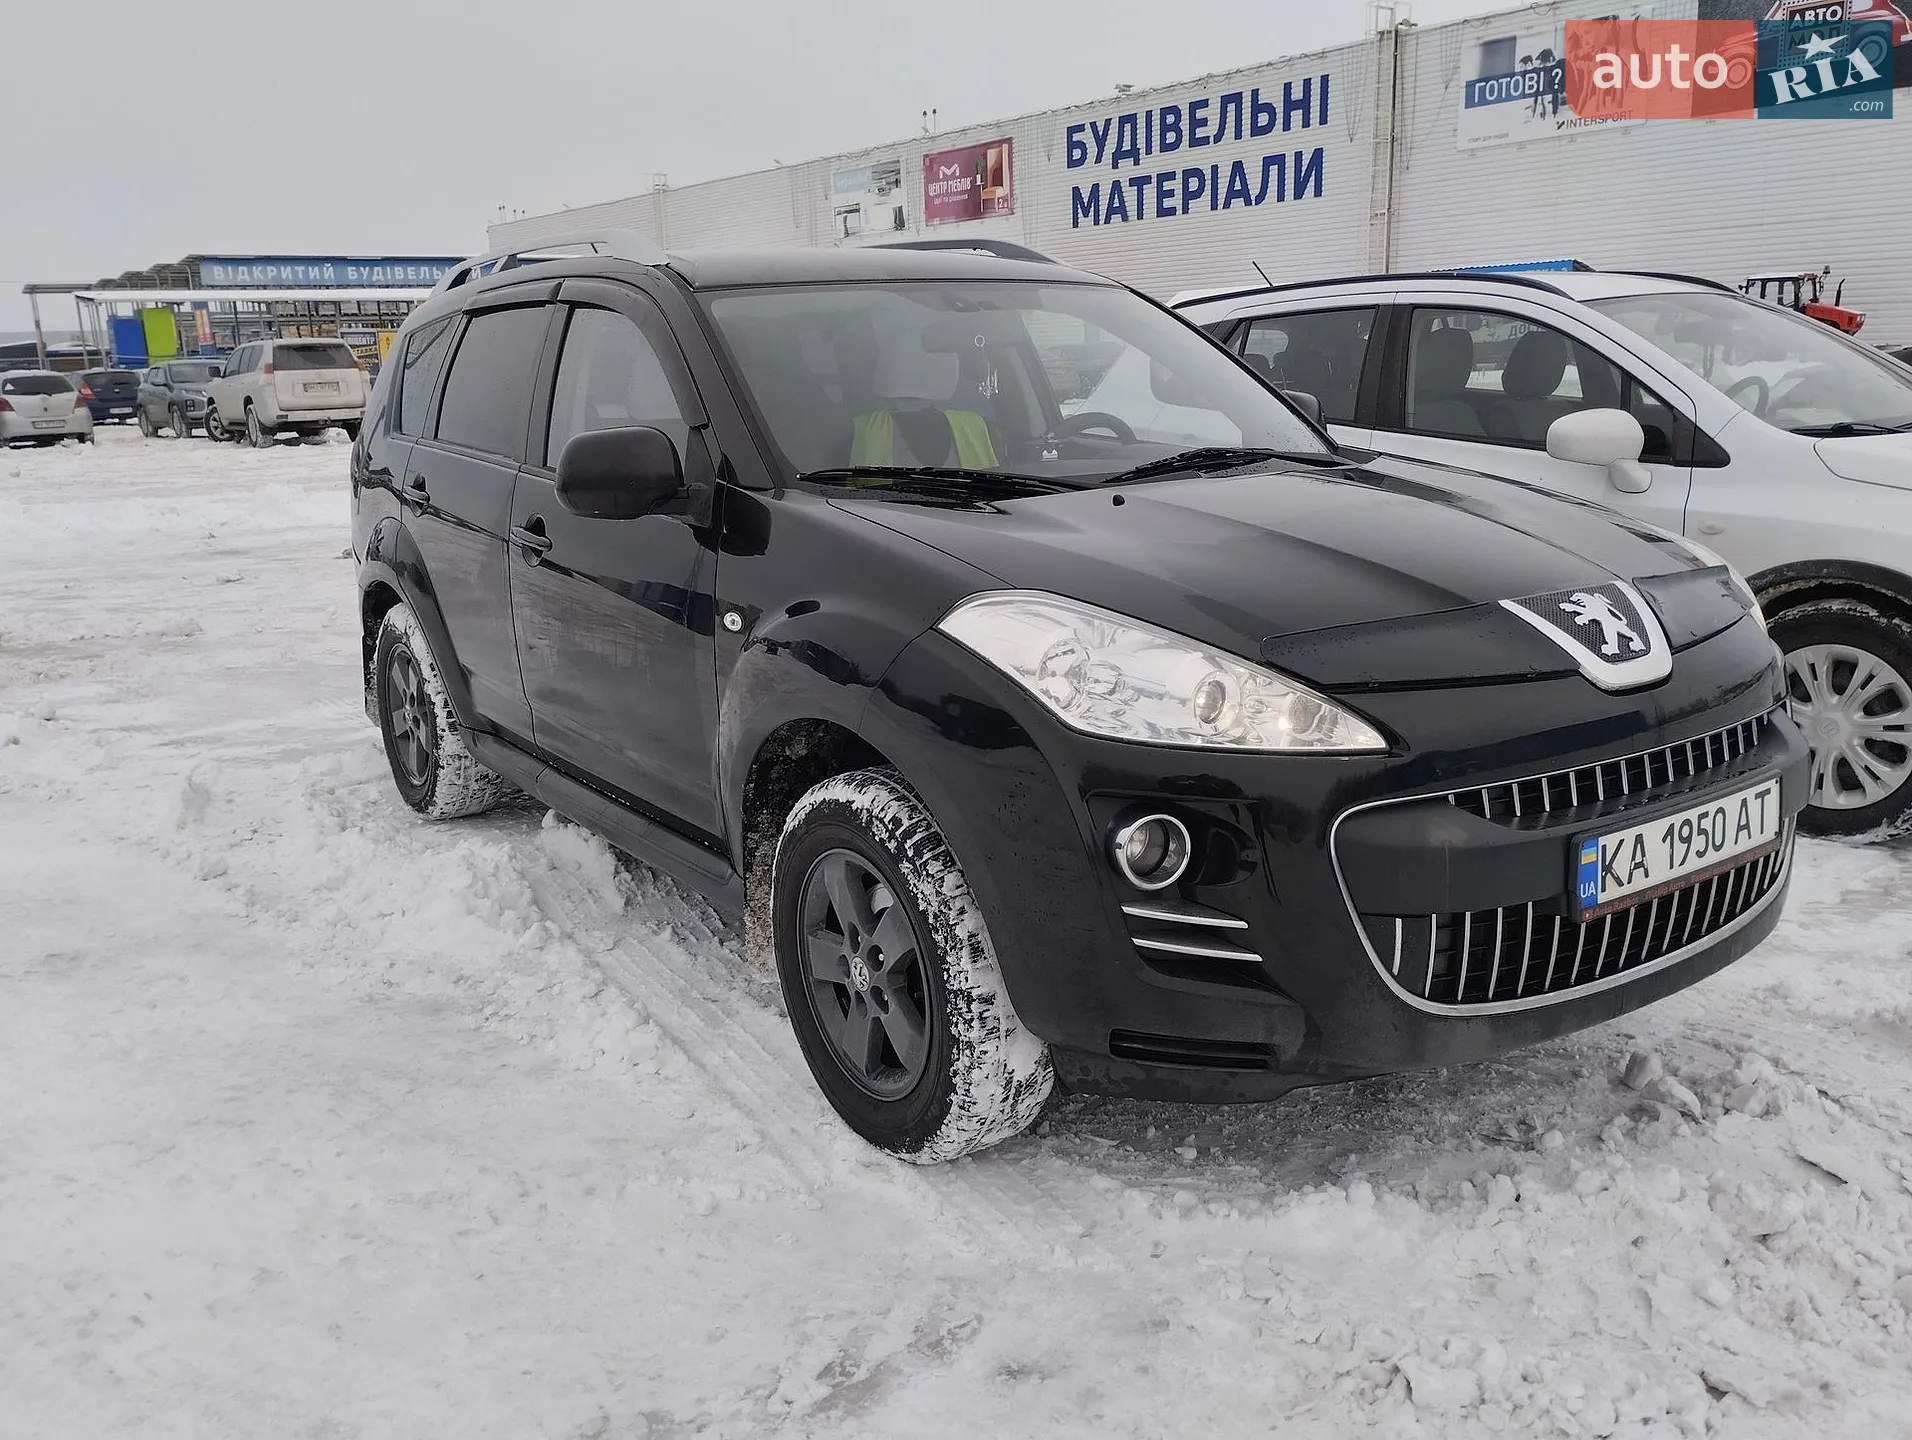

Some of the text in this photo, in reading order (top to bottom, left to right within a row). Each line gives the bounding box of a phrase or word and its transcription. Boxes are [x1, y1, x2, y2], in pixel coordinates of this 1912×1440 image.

[1789, 5, 1843, 30] АВТО
[1474, 72, 1545, 104] ГОТОВІ
[1066, 74, 1330, 169] БУДІВЕЛЬНІ
[1565, 110, 1634, 130] INTERSPORT
[928, 177, 972, 197] ЦЕНТР МЕБЛІВ
[1071, 147, 1324, 229] МАТЕРІАЛИ
[212, 263, 335, 282] ВІДКРИТИЙ
[1600, 787, 1772, 893] KA 1950 AT
[1580, 881, 1597, 899] UA
